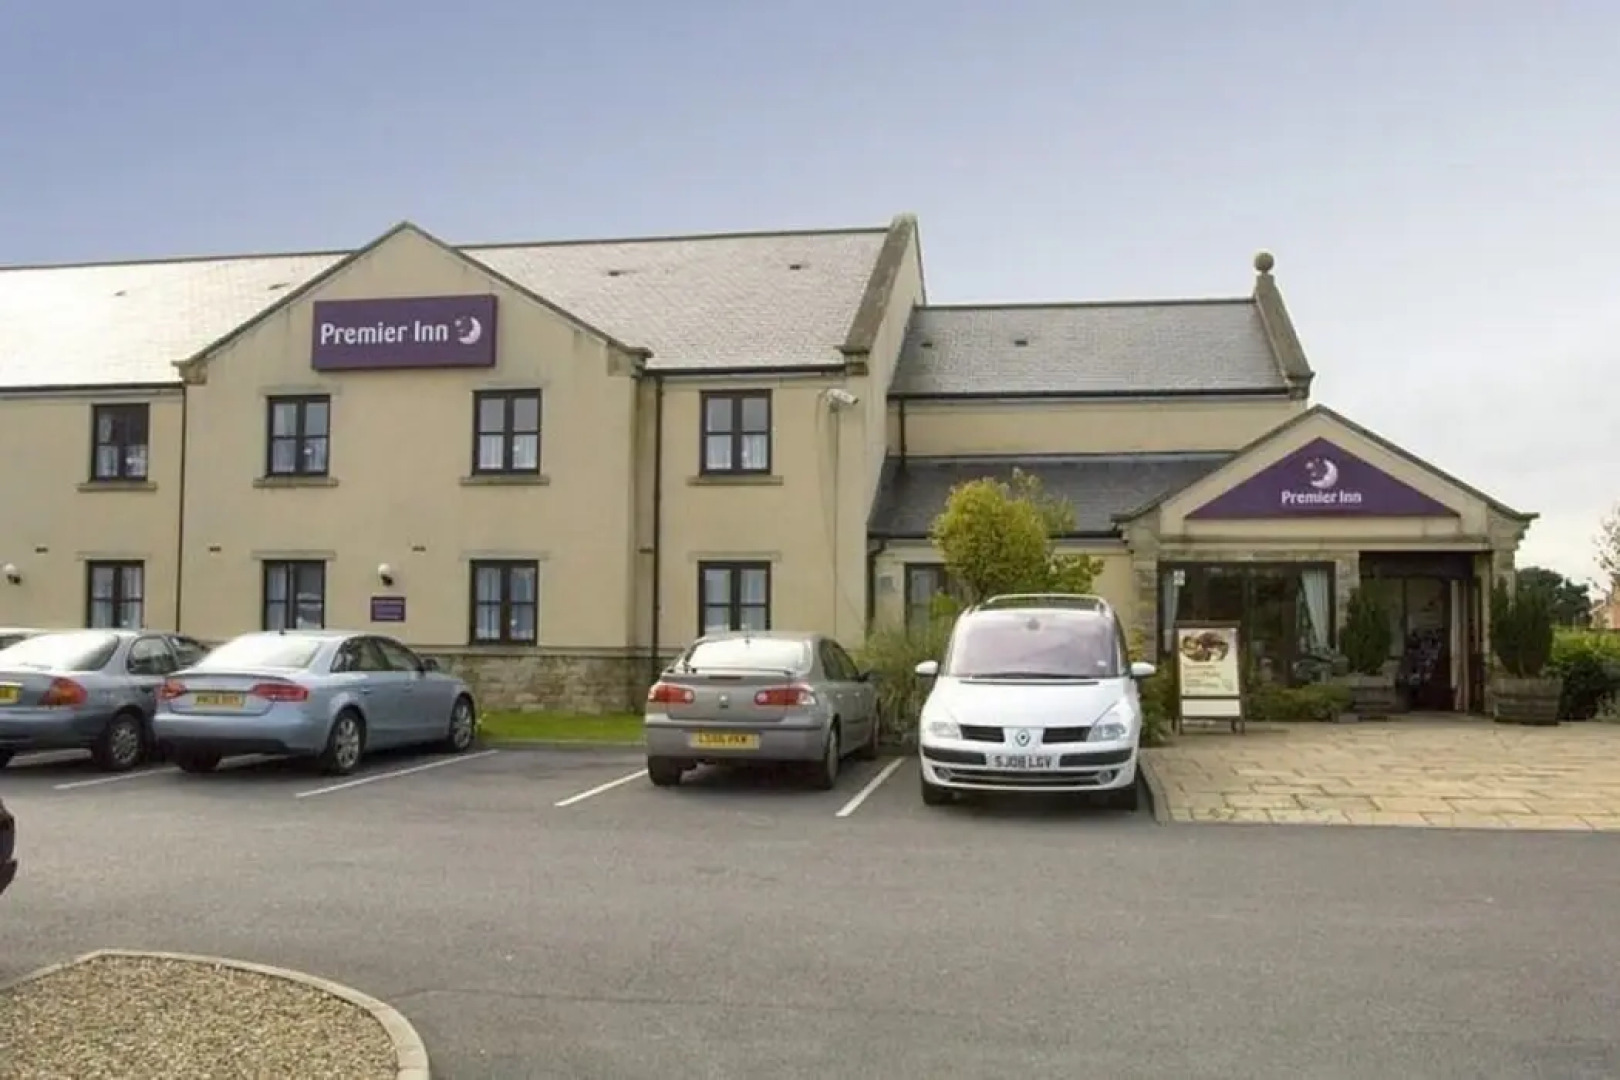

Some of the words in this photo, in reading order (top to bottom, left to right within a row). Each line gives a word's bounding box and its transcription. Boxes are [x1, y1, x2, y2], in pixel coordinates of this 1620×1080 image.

[320, 321, 408, 346] Premier
[414, 320, 449, 343] Inn
[1281, 490, 1337, 504] Premier
[1340, 489, 1362, 504] Inn
